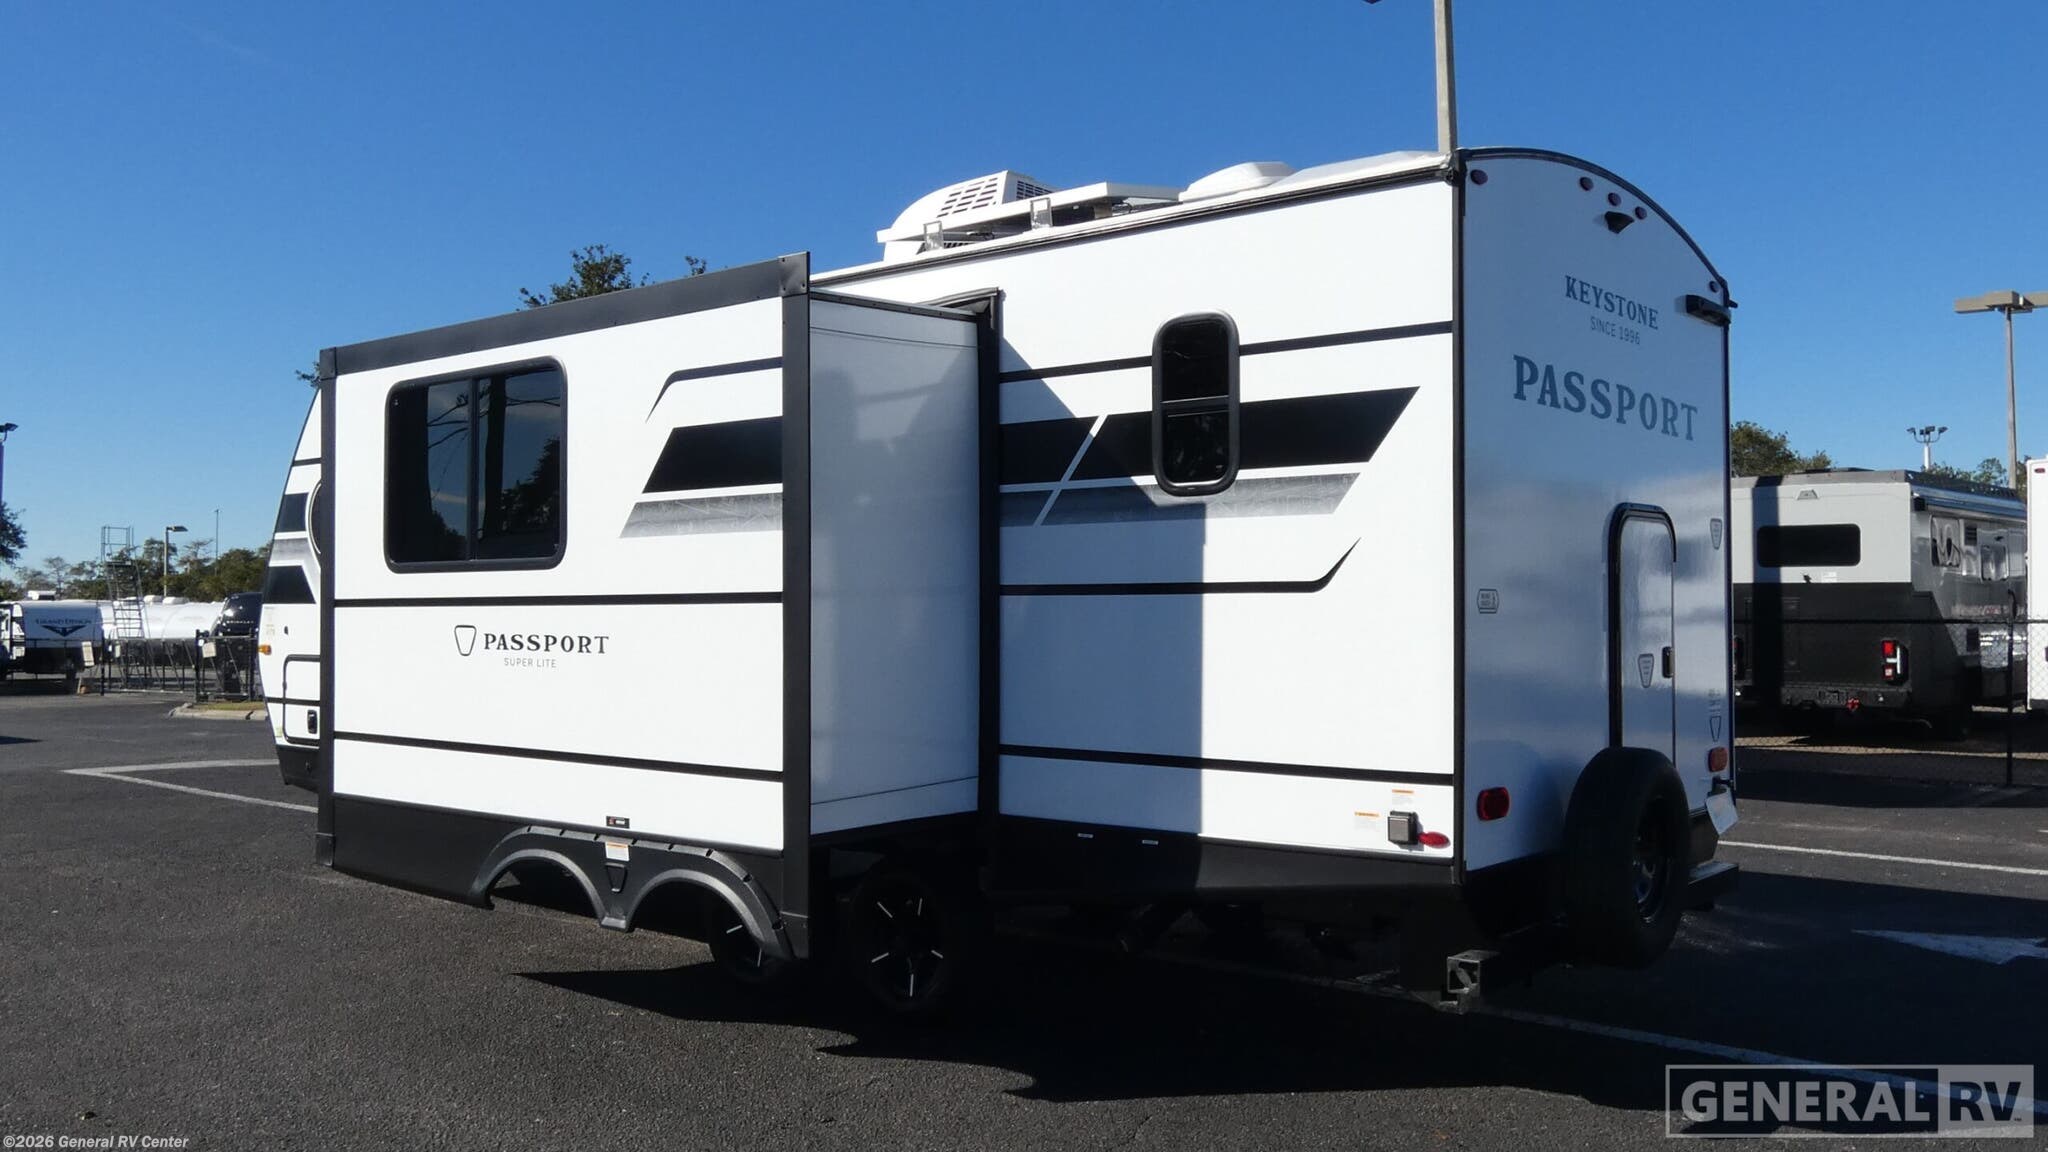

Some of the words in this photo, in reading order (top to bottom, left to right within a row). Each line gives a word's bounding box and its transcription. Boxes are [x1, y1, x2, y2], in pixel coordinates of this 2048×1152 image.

[1565, 275, 1659, 330] KEYSTONE
[1590, 316, 1616, 338] SINCE
[1619, 325, 1641, 345] 1996
[1513, 354, 1698, 441] PASSPORT
[484, 633, 609, 654] PASSPORT
[504, 657, 534, 668] SUPER
[536, 658, 557, 668] LITE
